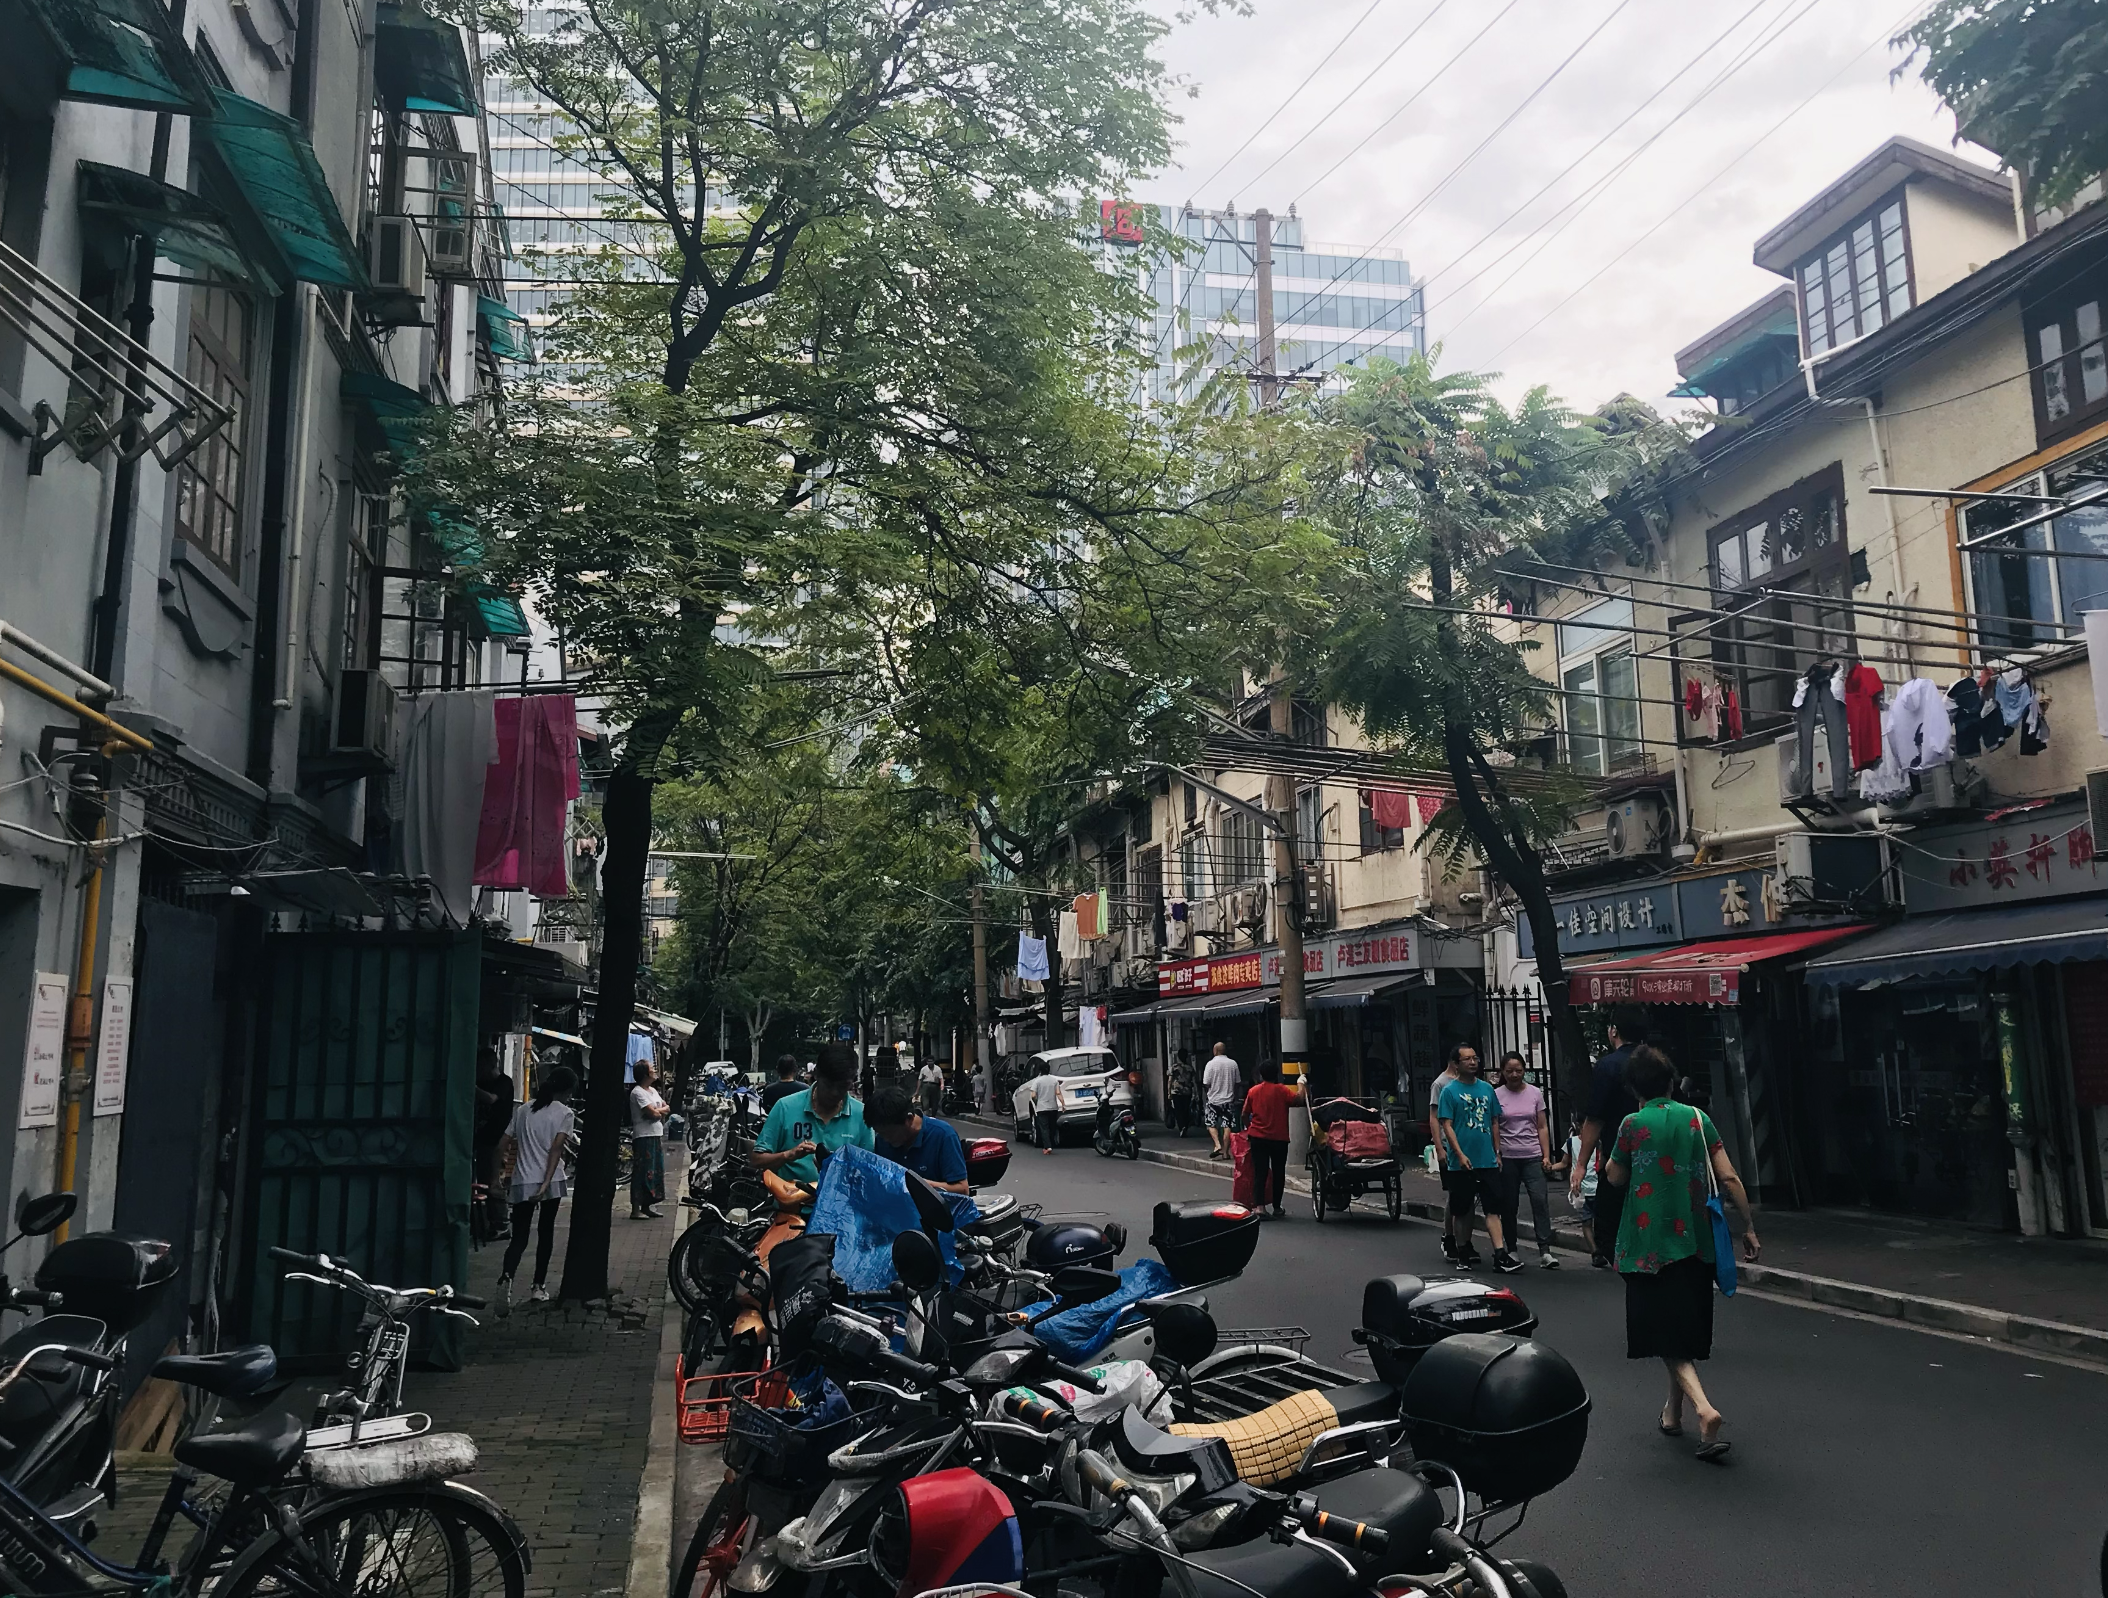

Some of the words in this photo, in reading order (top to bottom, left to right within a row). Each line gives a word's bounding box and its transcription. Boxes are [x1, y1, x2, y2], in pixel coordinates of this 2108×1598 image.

[1337, 936, 1410, 968] 卢湾三友副食品店
[793, 1122, 813, 1140] 03
